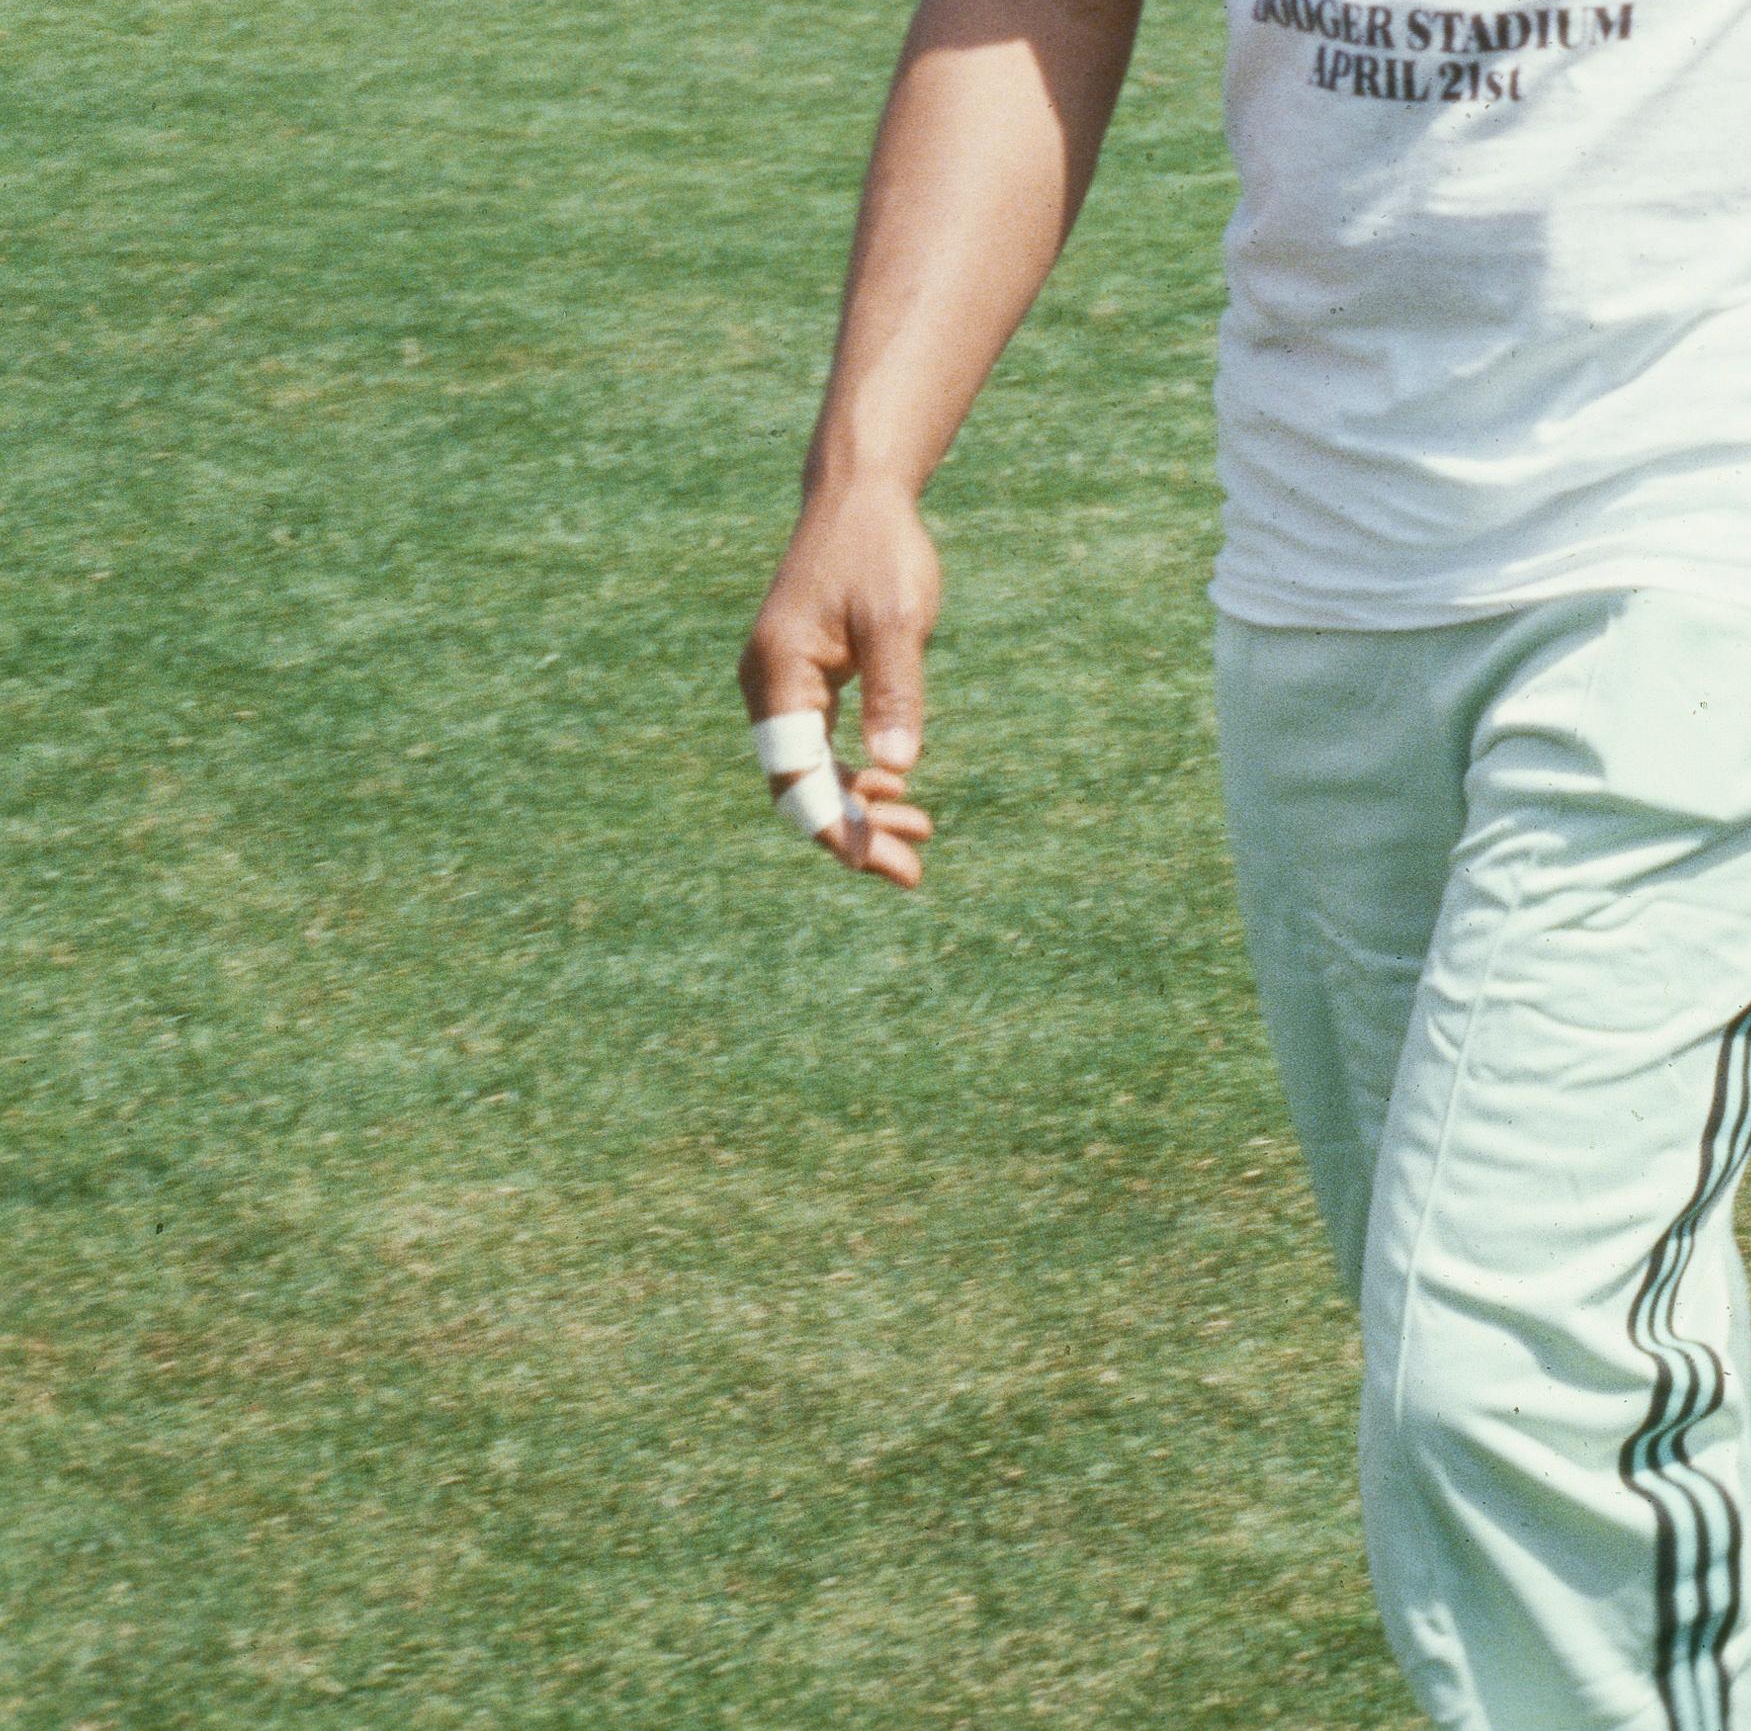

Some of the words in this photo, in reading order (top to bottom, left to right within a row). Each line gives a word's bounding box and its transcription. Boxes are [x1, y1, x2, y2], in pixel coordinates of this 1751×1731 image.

[1406, 1, 1634, 55] STADIUM
[1308, 44, 1431, 103] APRIL
[1437, 61, 1522, 103] 21st
